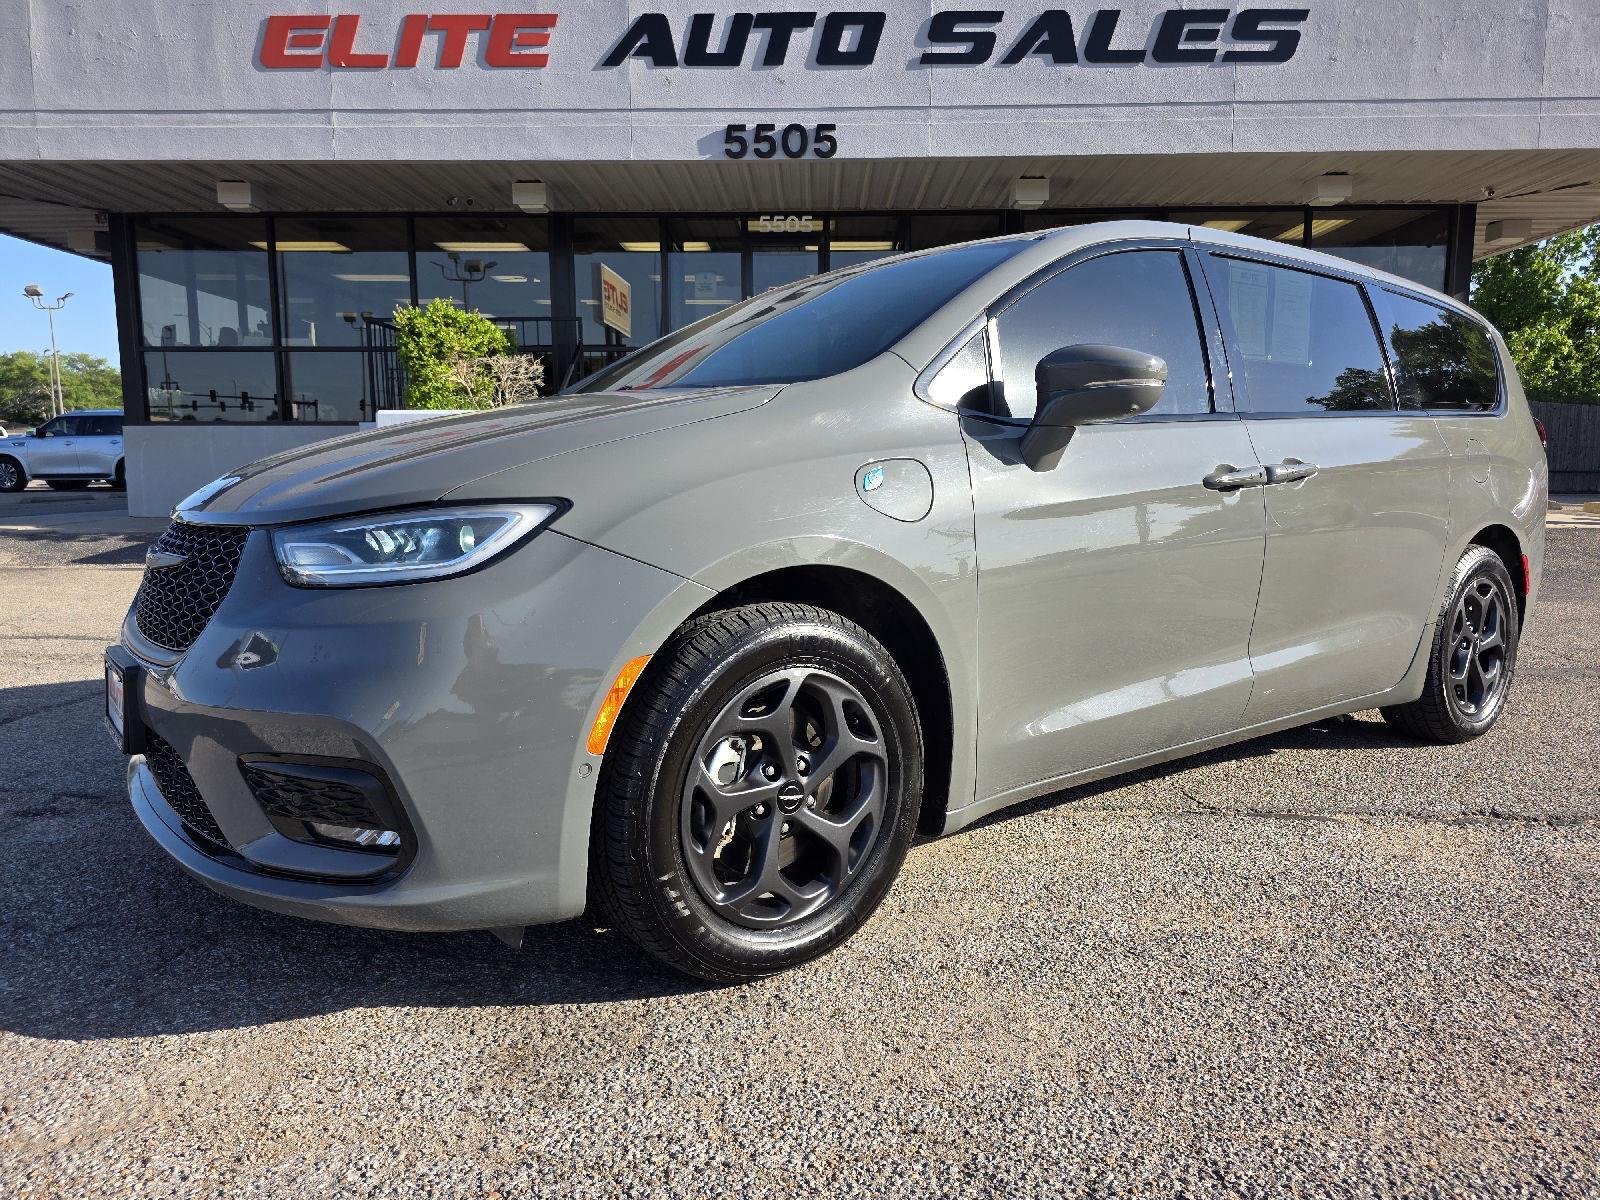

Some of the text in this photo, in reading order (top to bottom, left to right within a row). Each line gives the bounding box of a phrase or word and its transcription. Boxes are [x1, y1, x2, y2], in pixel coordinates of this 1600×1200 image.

[259, 8, 1311, 69] ELITE AUTO SALES
[724, 123, 838, 159] 5505
[759, 215, 814, 233] 5505
